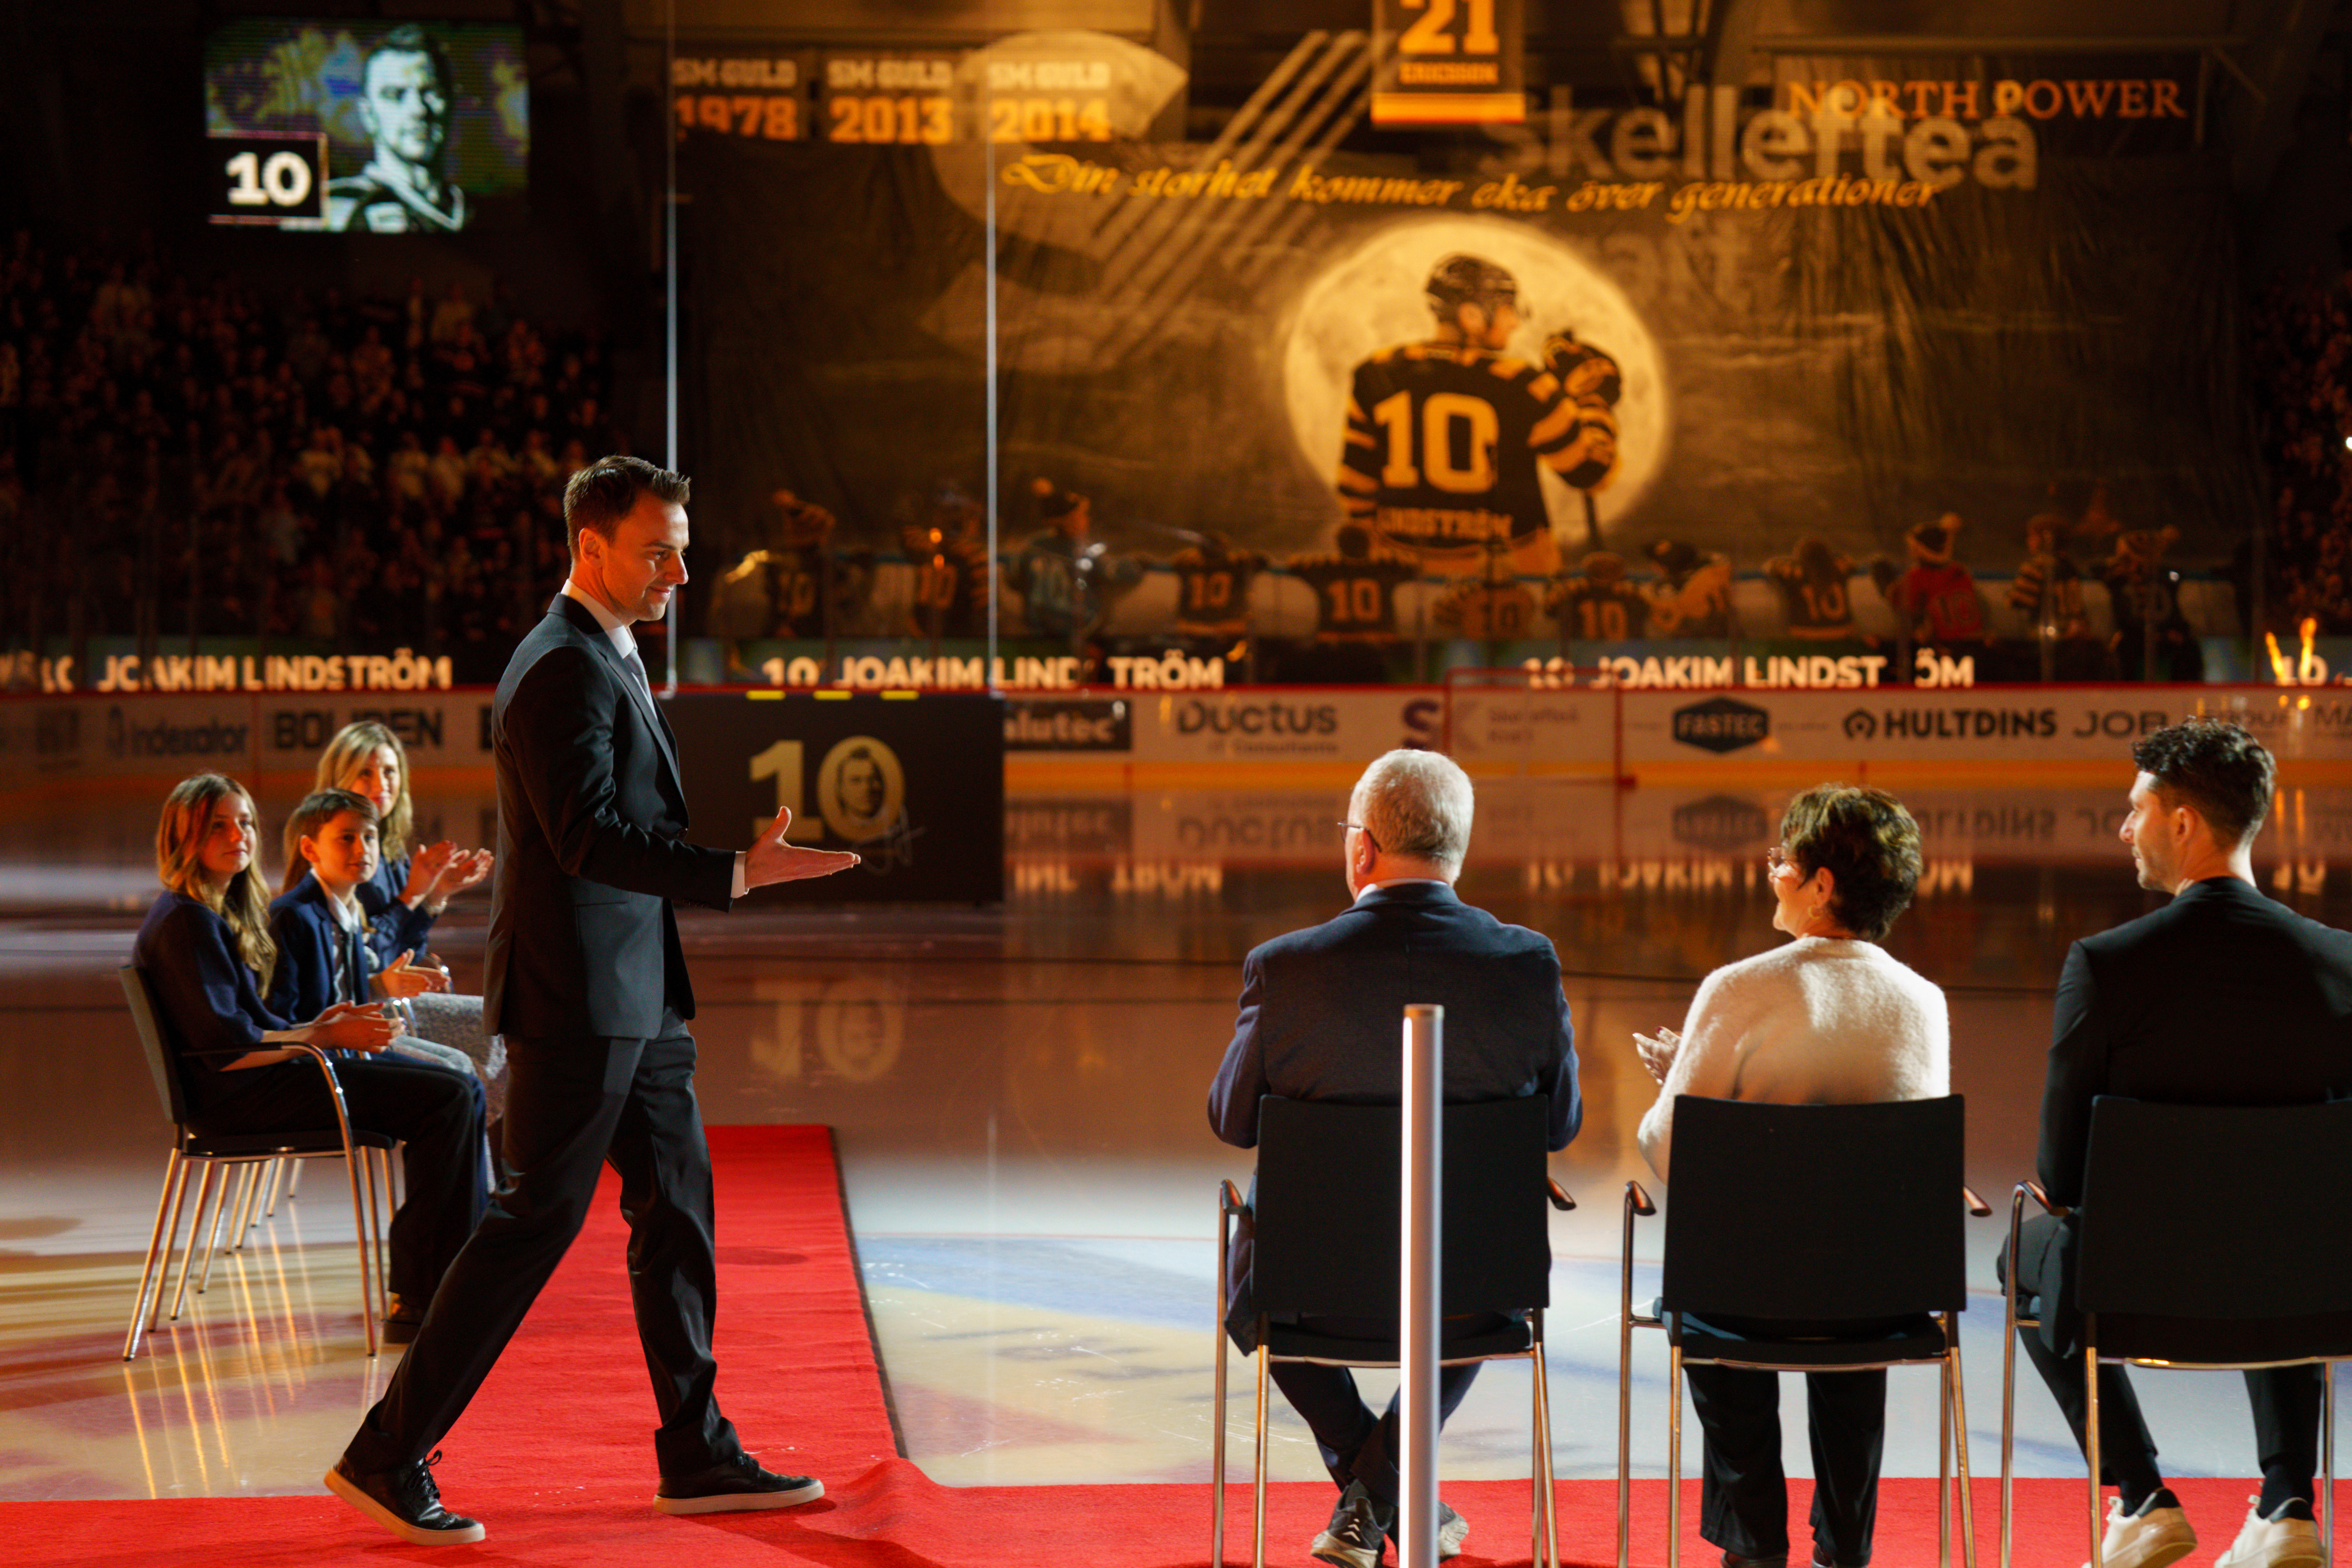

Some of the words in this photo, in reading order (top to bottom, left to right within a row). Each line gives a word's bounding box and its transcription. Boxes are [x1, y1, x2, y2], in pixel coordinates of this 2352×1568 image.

[1398, 0, 1499, 55] 21
[672, 59, 716, 87] SM
[722, 59, 797, 87] GULD
[827, 60, 873, 89] SM
[878, 60, 952, 88] GULD
[988, 61, 1032, 90] SM
[1037, 61, 1110, 90] GULD
[674, 95, 797, 142] 1978
[829, 96, 953, 144] 2013
[990, 97, 1111, 143] 2014
[1788, 78, 1979, 119] NORTH
[1993, 78, 2187, 119] POWER
[226, 151, 311, 207] 10
[1001, 153, 1119, 194] Din
[1288, 163, 1465, 205] kommer
[1471, 173, 1558, 213] eka
[1565, 179, 1665, 213] över
[1665, 173, 1943, 225] generationer
[1373, 389, 1500, 495] 10
[1328, 579, 1382, 623] 10
[1582, 599, 1628, 642] 10
[1801, 584, 1845, 620] 10
[243, 647, 453, 691] LINDSTRÖM
[762, 656, 820, 687] 10
[833, 656, 984, 690] JOAKIM
[993, 648, 1225, 690] LINDTRÖM
[1590, 655, 1733, 690] JOAKIM
[1743, 647, 1975, 689] LINDSTÖM
[1177, 700, 1338, 735] Ductus
[1884, 709, 2057, 738] HULTDINS
[748, 735, 906, 843] 10
